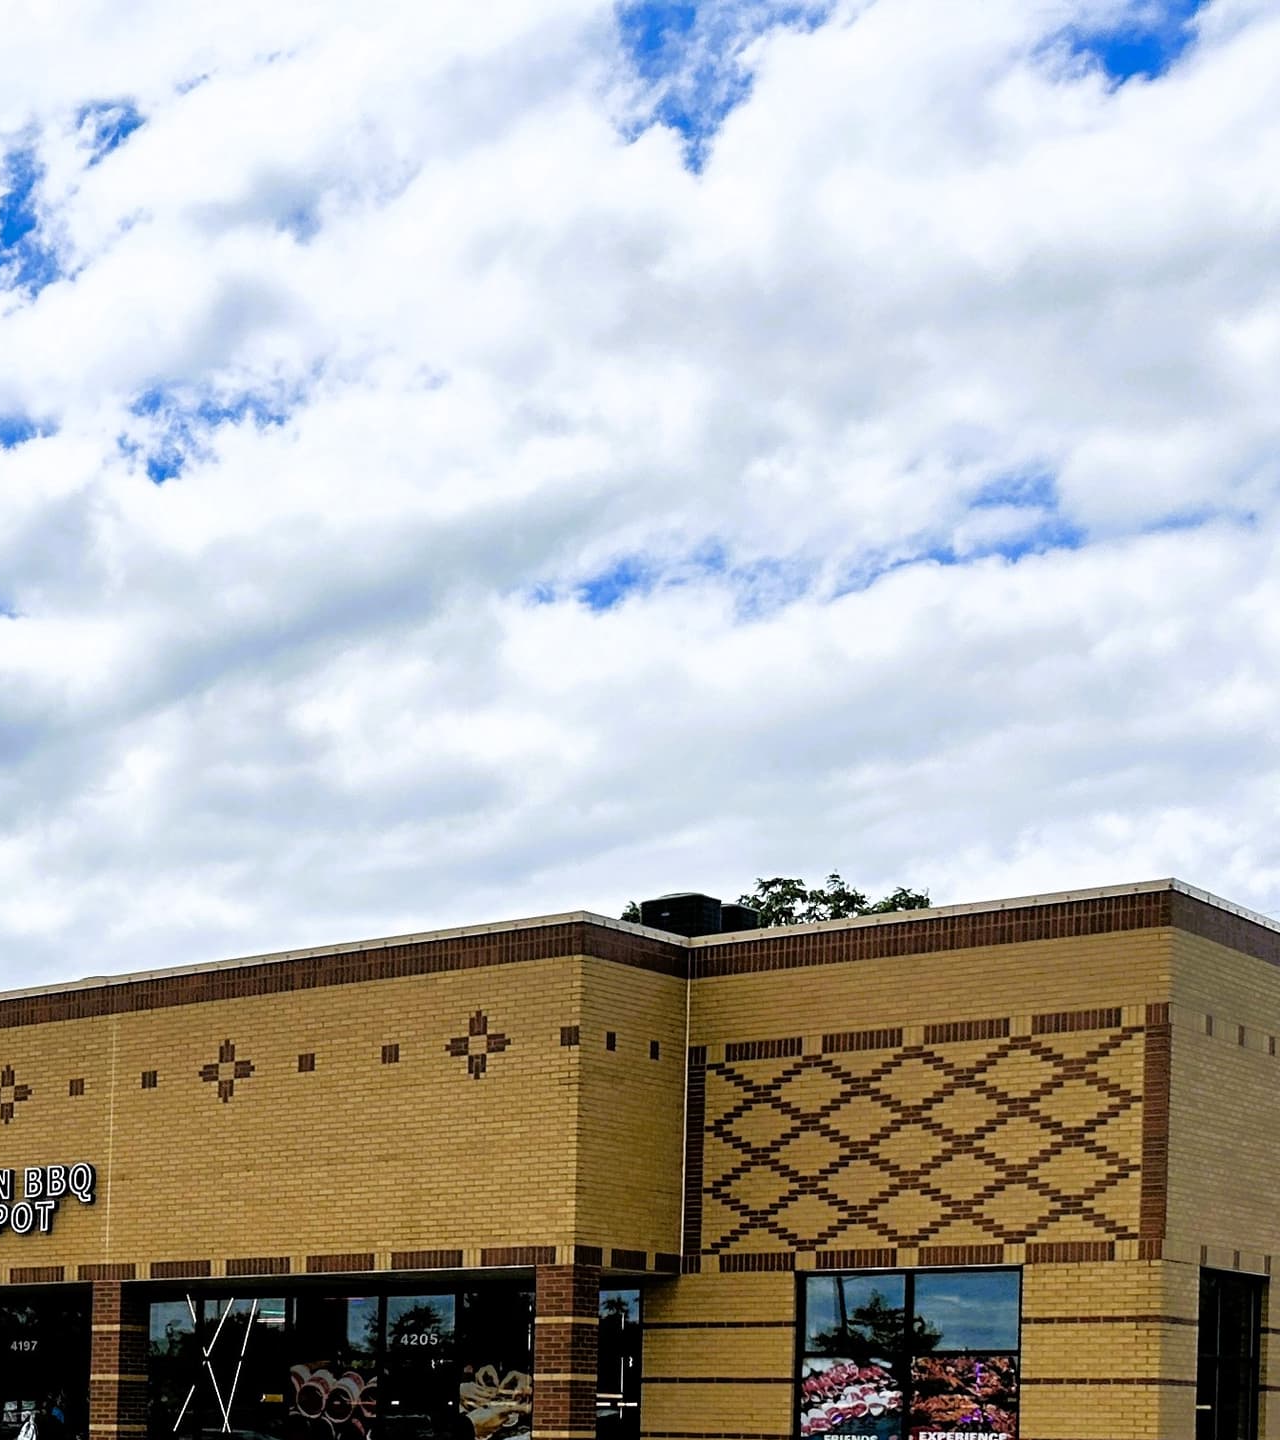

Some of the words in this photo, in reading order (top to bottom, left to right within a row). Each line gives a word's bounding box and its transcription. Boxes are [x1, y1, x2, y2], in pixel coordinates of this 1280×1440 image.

[23, 1162, 95, 1203] BBQ
[400, 1333, 438, 1345] 4205
[10, 1340, 38, 1351] 4197
